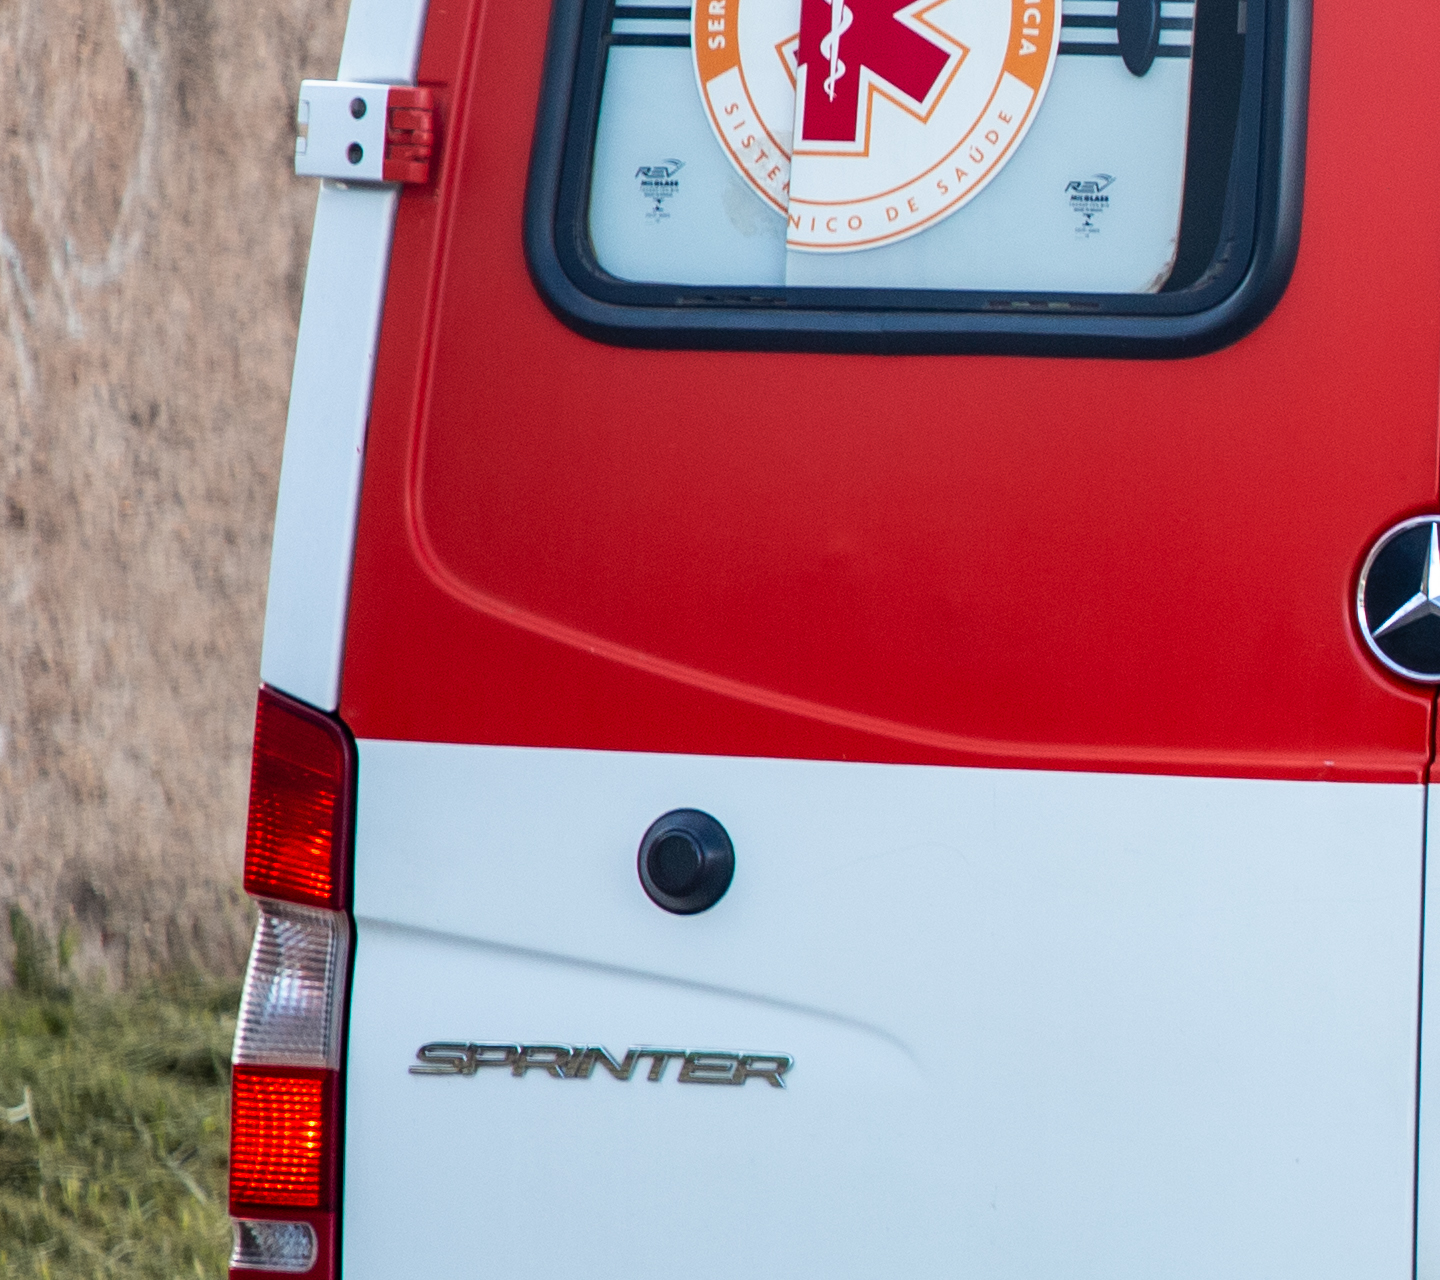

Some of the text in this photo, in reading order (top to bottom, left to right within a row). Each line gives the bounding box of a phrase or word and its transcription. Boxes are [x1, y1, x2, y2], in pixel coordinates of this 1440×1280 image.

[788, 214, 863, 234] NICO
[885, 196, 919, 223] DE
[936, 109, 1014, 196] SAÚDE
[408, 1040, 795, 1089] SPRINTER
